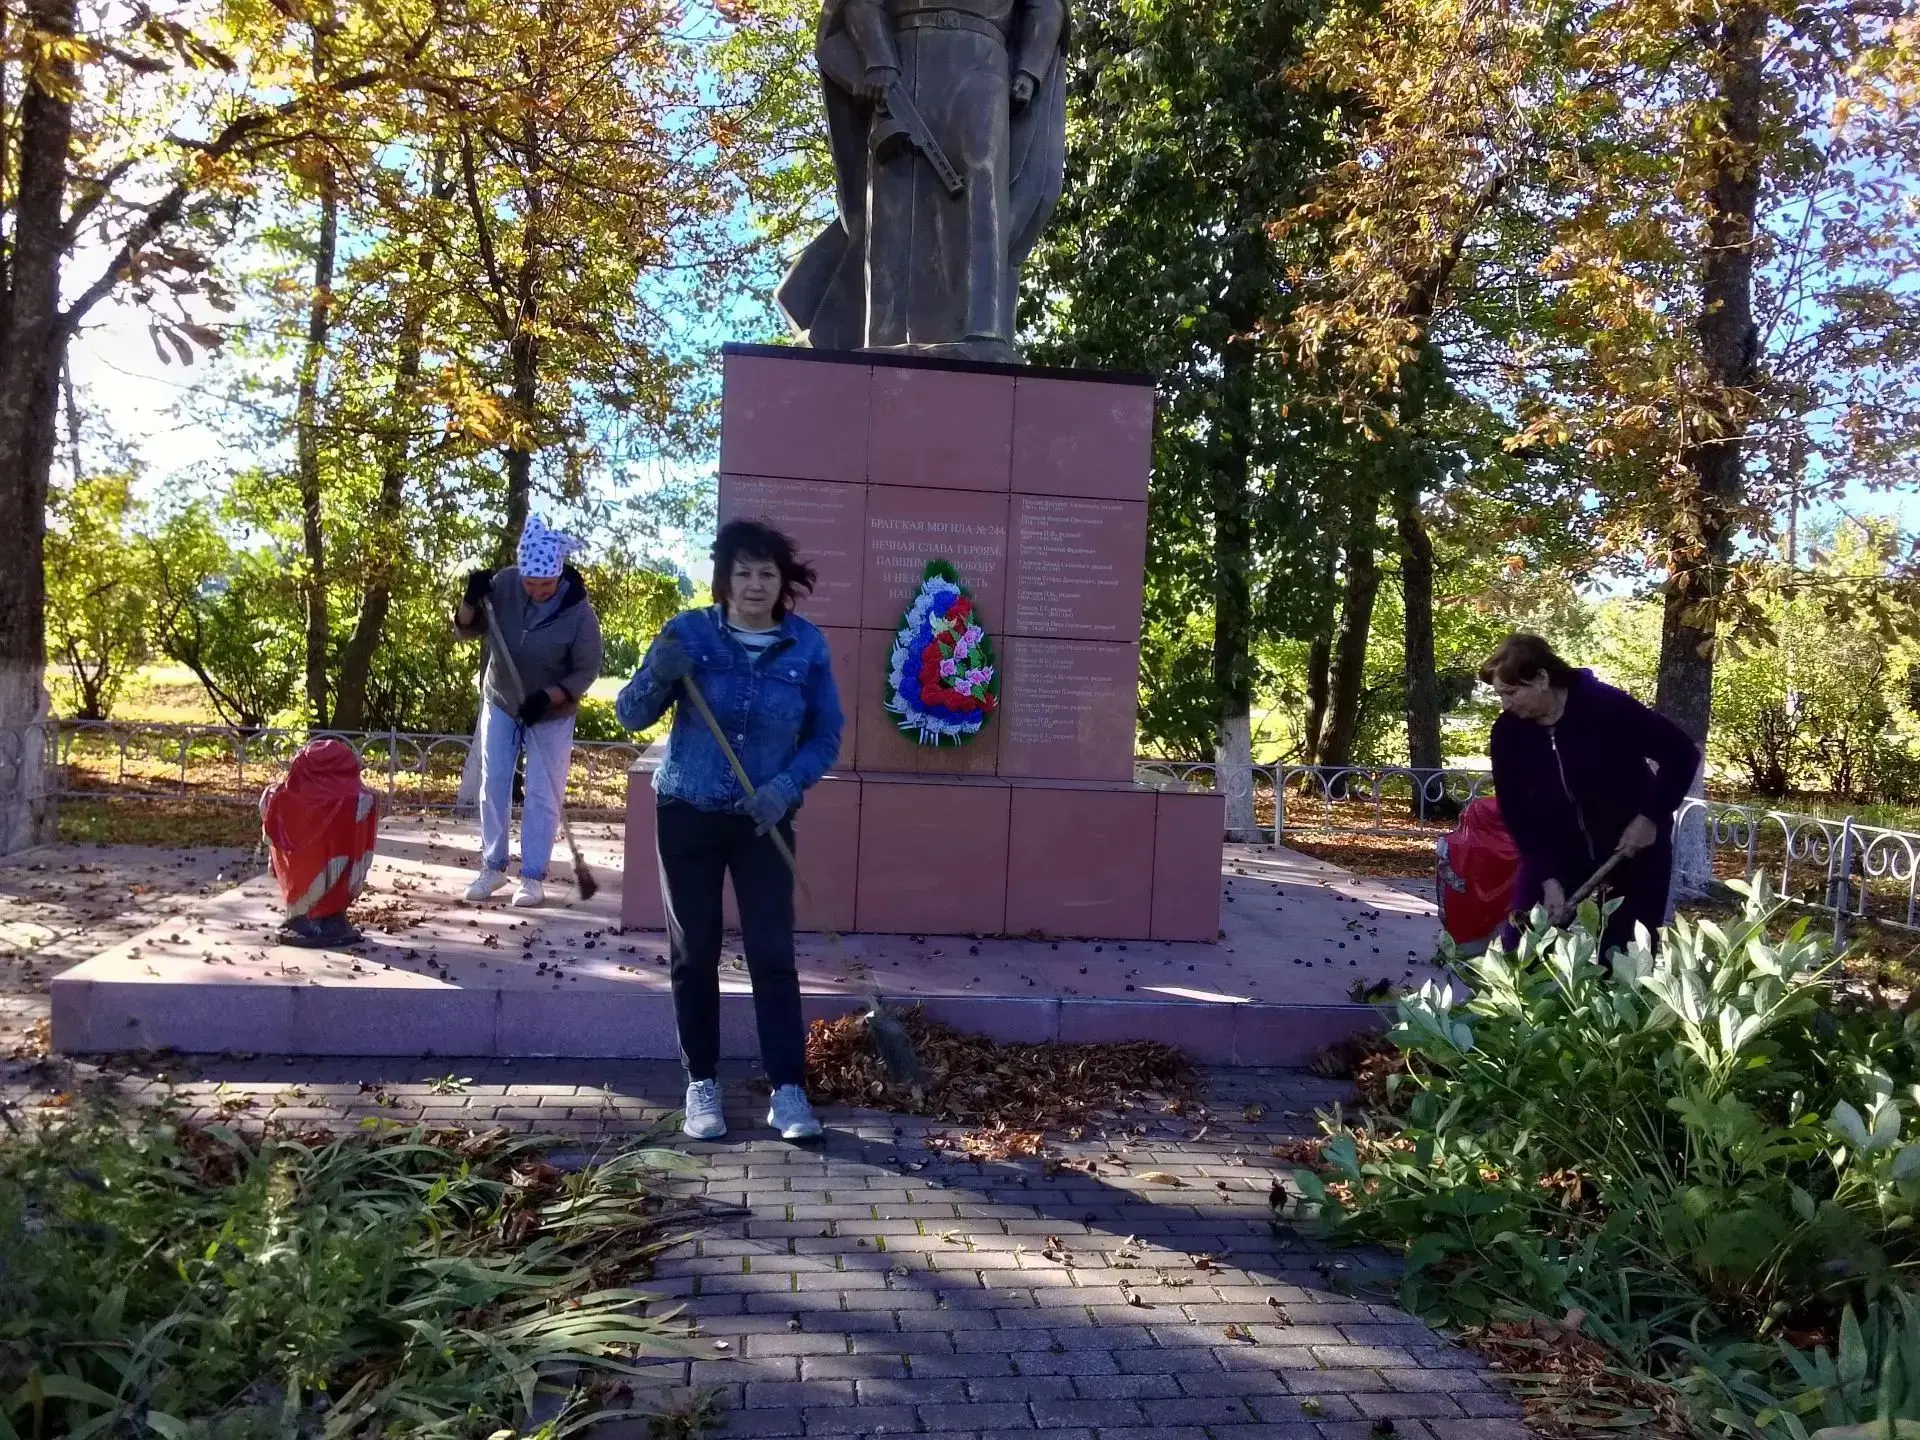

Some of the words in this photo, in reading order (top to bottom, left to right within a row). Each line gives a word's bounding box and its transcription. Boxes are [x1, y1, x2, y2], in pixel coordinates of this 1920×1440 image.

[871, 518, 924, 532] БРАТСКАЯ
[927, 521, 973, 535] МОГИЛА
[871, 539, 915, 552] ВЕЧНАЯ
[918, 542, 954, 554] СЛАВА
[876, 556, 927, 569] ПАВШИМ
[950, 560, 996, 573] ВОБОДУ
